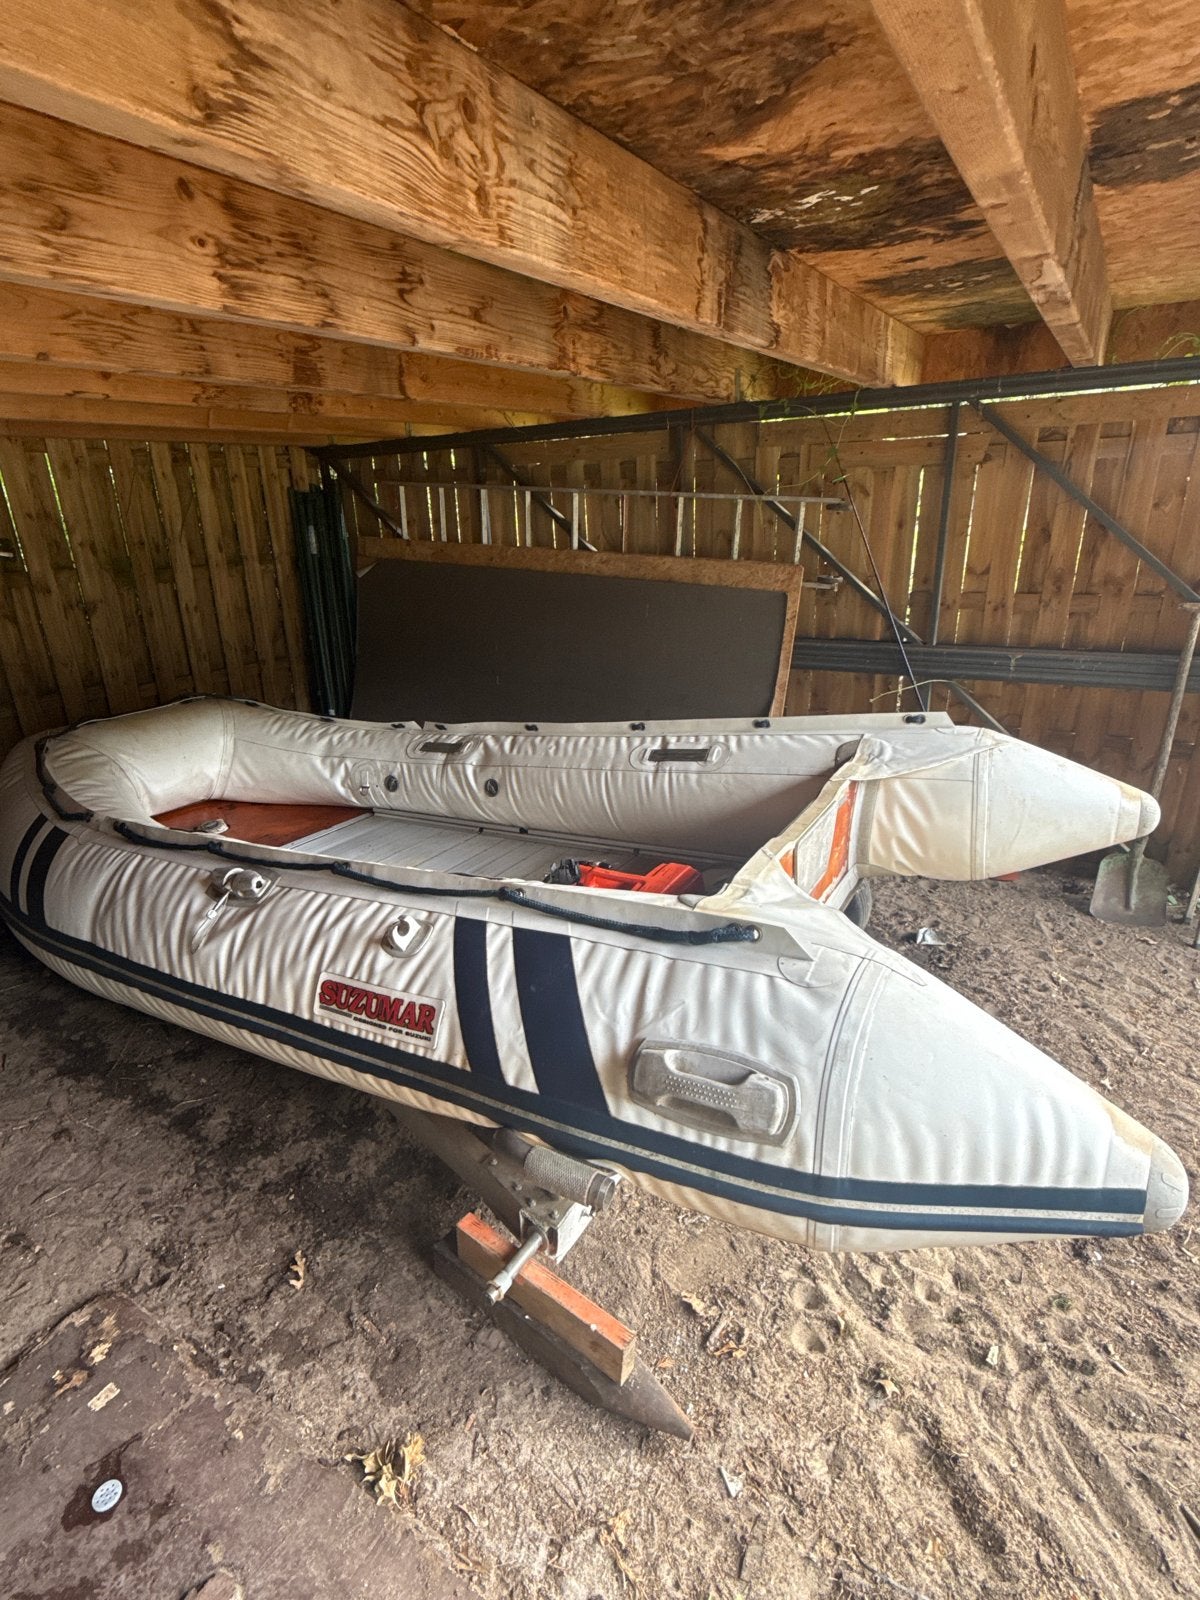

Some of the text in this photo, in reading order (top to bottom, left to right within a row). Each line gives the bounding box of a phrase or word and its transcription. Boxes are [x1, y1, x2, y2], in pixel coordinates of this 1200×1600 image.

[318, 979, 436, 1035] SUZUMAR
[353, 1016, 432, 1042] DESIGNED FOR SUZUKI
